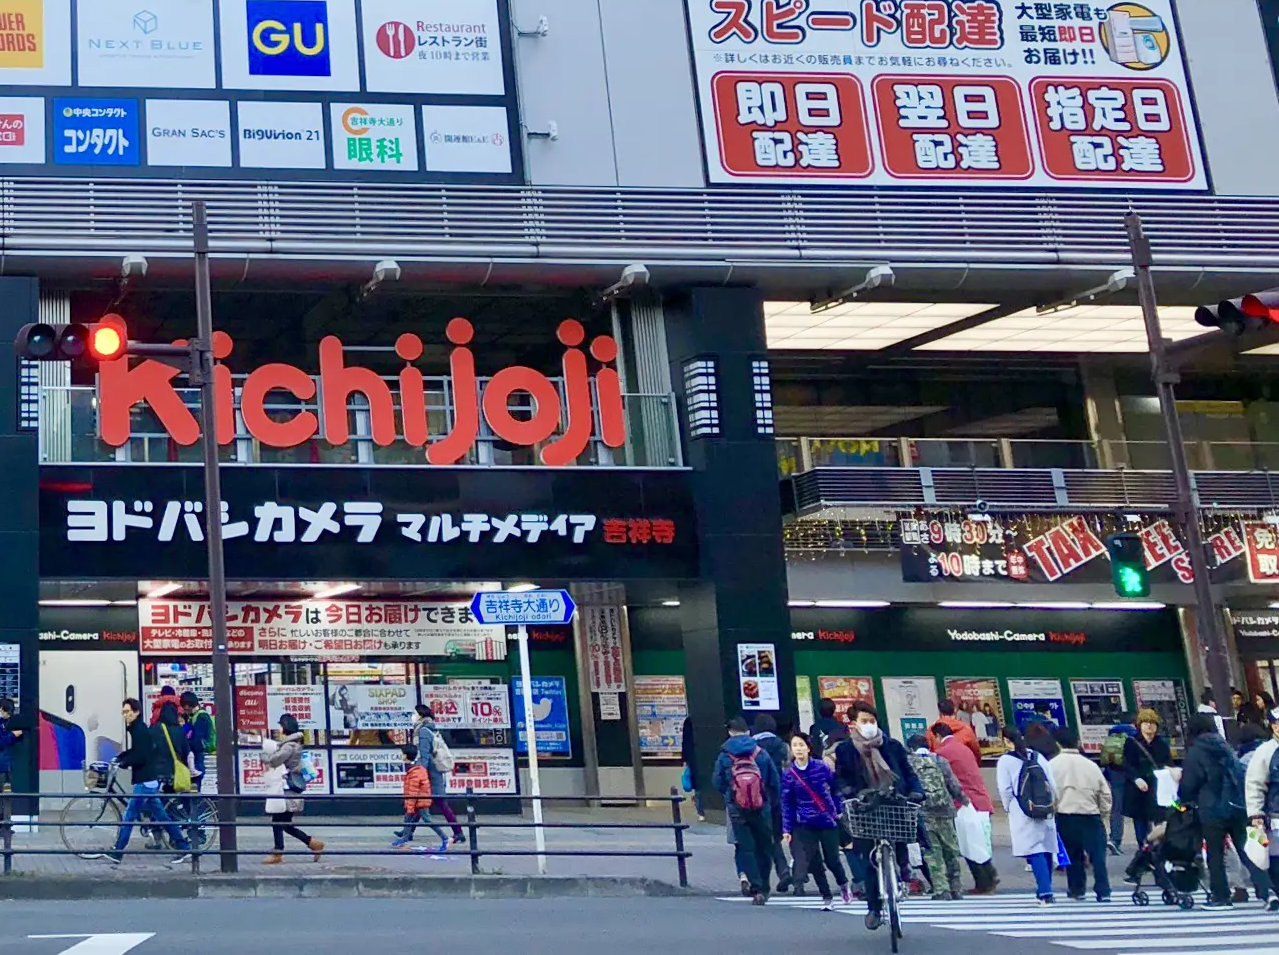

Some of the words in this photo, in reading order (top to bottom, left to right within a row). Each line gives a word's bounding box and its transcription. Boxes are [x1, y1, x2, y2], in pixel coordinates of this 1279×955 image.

[1014, 2, 1109, 21] 大型家電も
[416, 20, 487, 34] Restaurant
[1019, 25, 1096, 44] 最短即日
[87, 38, 141, 50] NEXT
[150, 39, 204, 51] BLUE
[252, 19, 325, 56] GU
[417, 35, 488, 49] レストラン街
[73, 107, 128, 118] 中央コンタクト
[734, 80, 843, 128] 即日
[891, 82, 1002, 130] 翌日
[1043, 84, 1172, 133] 指定日
[350, 116, 404, 127] 吉祥寺大通り
[63, 127, 130, 156] コンタクト
[151, 126, 187, 139] GRAN
[305, 129, 320, 141] 21
[346, 136, 404, 164] 眼科
[751, 129, 842, 170] 配達
[912, 131, 1001, 172] 配達
[1068, 133, 1166, 173] 配達
[395, 511, 597, 544] マルチメディア
[601, 515, 676, 545] 吉祥寺
[1023, 514, 1106, 582] TAX
[1171, 525, 1247, 585] SRE
[937, 551, 1009, 577] 10時まで
[485, 598, 561, 614] 吉祥寺大通り
[495, 612, 529, 622] Kichijoji
[531, 612, 552, 620] odori
[258, 627, 287, 638] さらに
[947, 628, 1046, 642] Yodobashi-Camera
[368, 687, 407, 698] SIXPAD
[349, 753, 370, 761] GOLD
[370, 753, 390, 761] POINT
